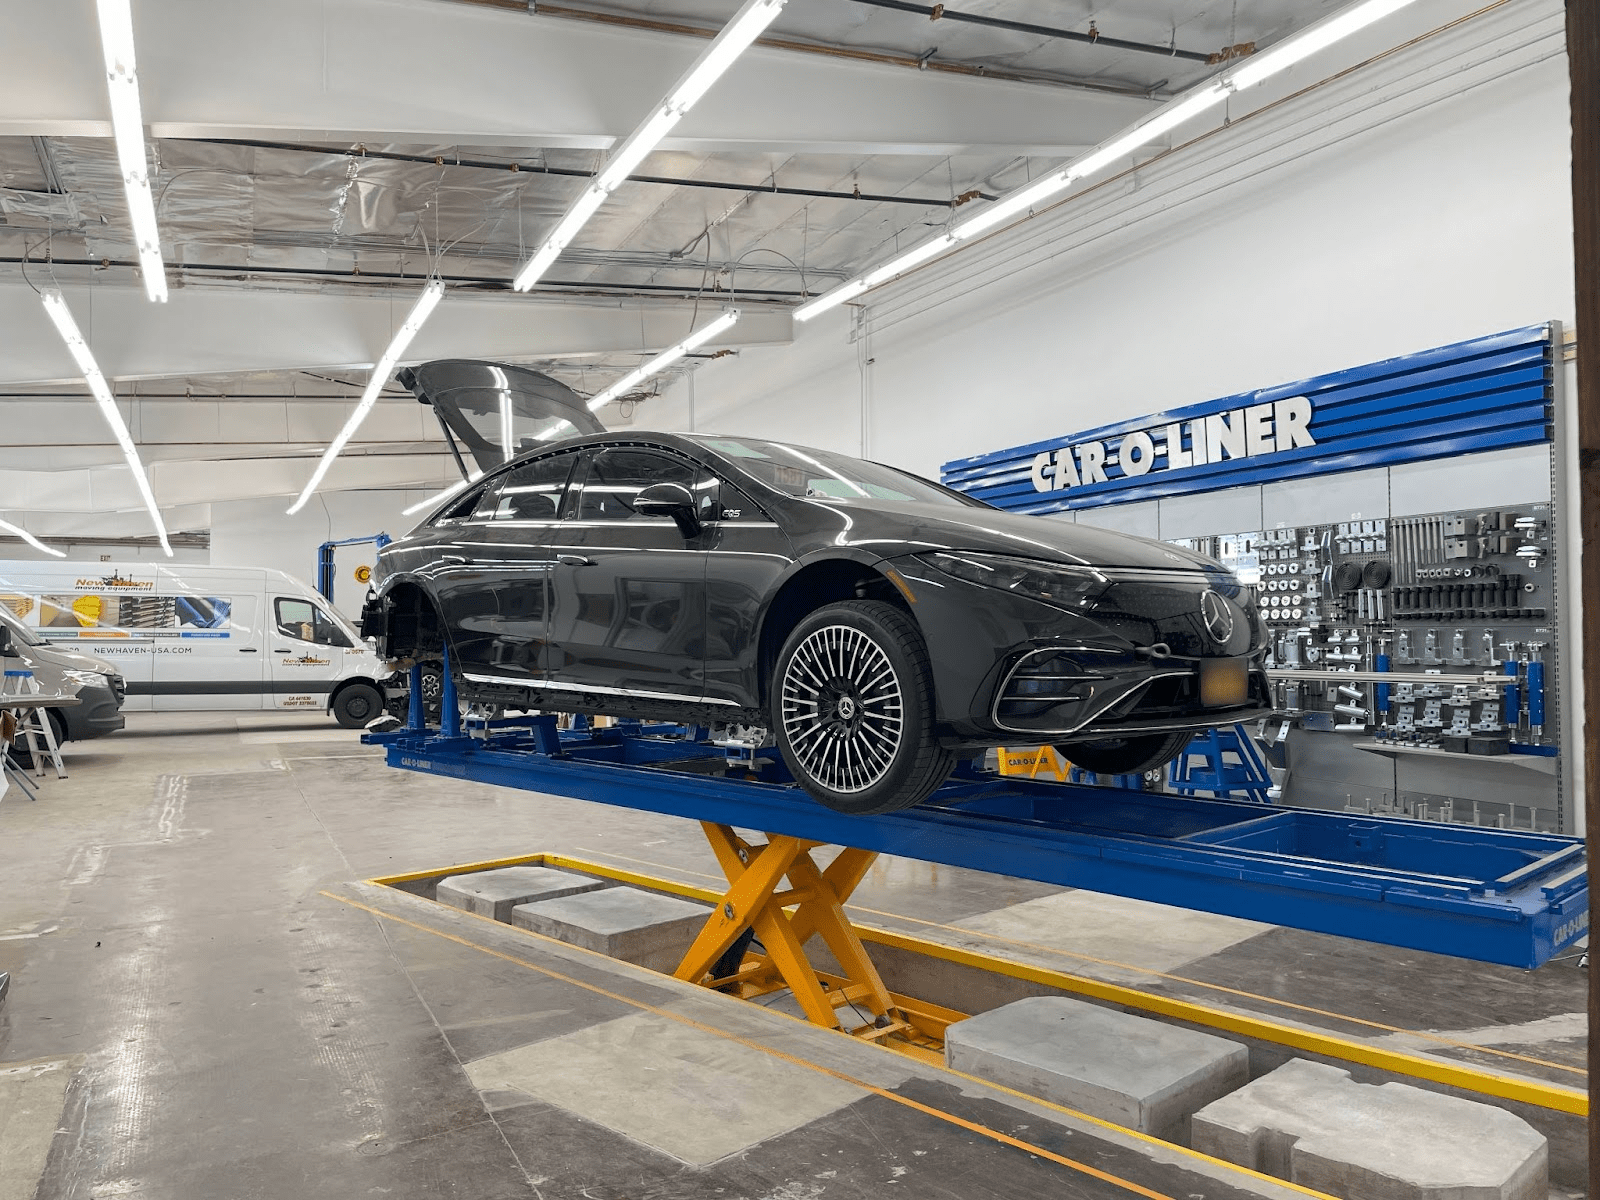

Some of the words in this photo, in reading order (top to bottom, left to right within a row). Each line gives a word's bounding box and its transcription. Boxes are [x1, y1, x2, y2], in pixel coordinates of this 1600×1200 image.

[1031, 396, 1316, 493] CAR-O-LINER
[722, 509, 742, 518] EQS
[1008, 757, 1049, 766] CAR-O-LIER
